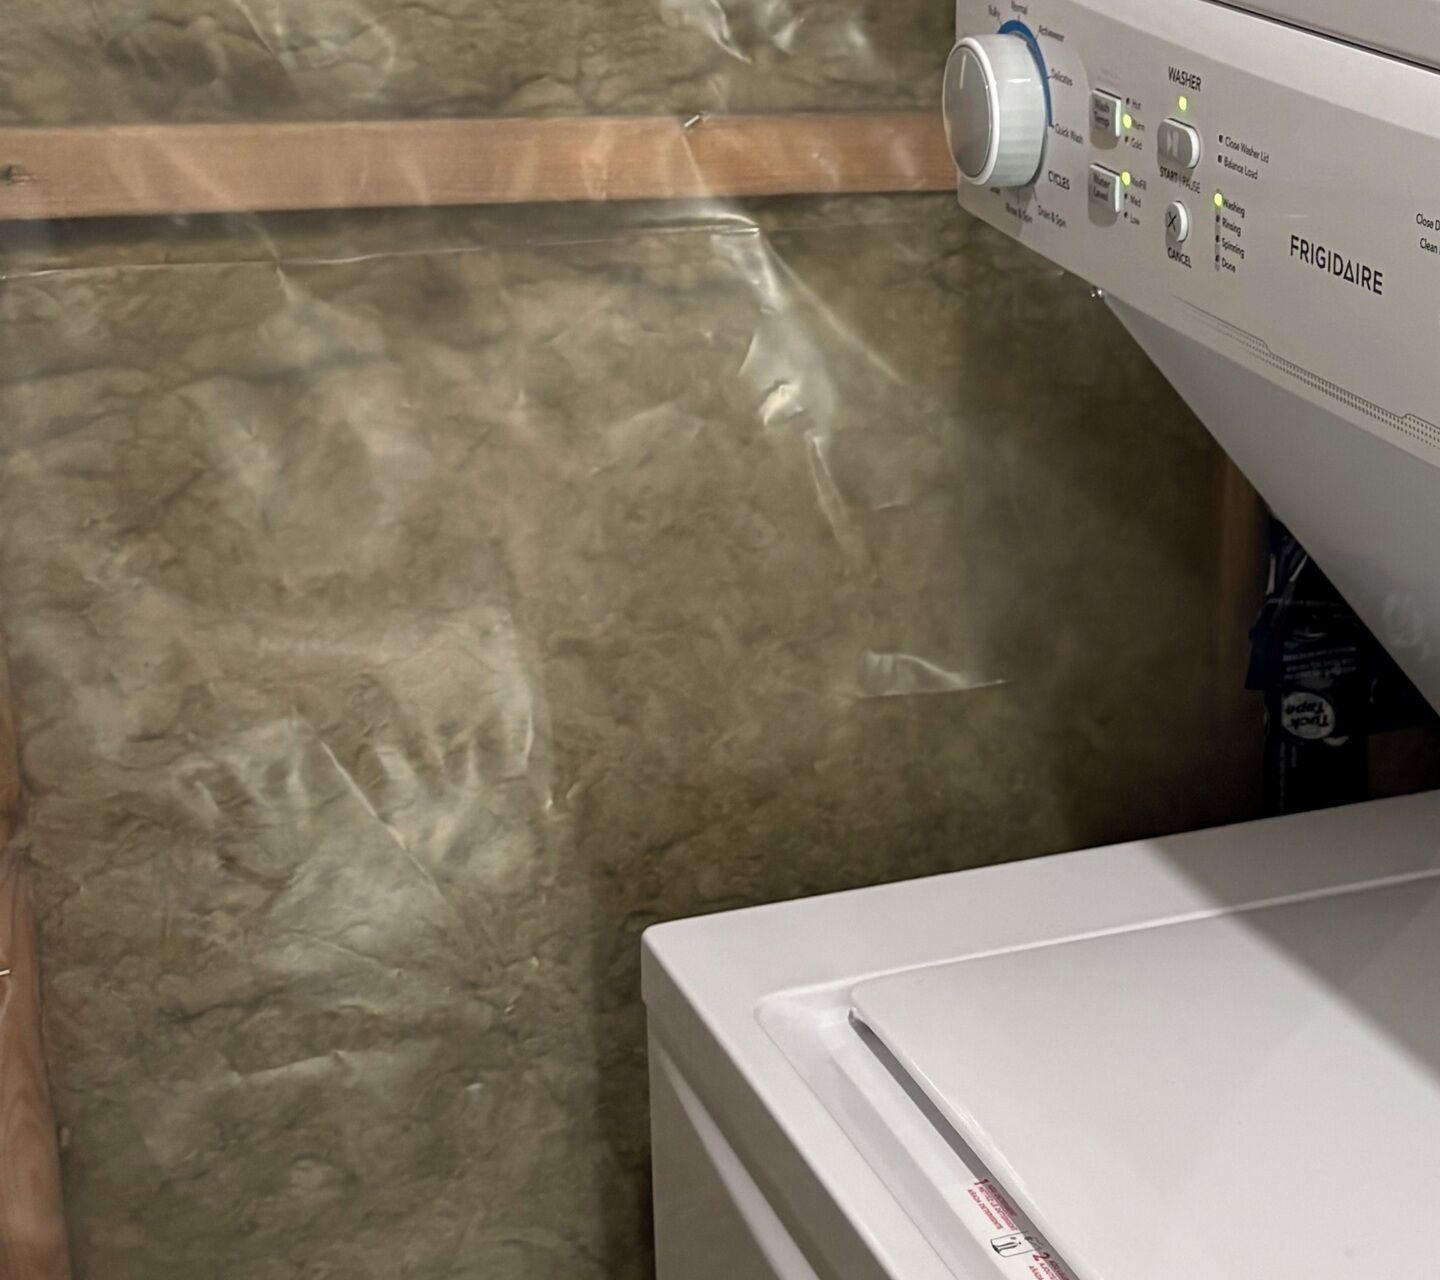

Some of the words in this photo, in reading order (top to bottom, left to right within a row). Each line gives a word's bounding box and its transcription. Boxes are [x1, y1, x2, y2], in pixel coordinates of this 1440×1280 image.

[1167, 66, 1202, 92] WASHER
[1225, 136, 1240, 151] Close
[1240, 142, 1260, 159] Washer
[1260, 151, 1269, 163] Lid
[1224, 155, 1243, 174] Balance
[1244, 165, 1258, 180] Load
[1048, 170, 1070, 190] CYCLES
[1160, 166, 1178, 184] START
[1182, 174, 1201, 194] PAUSE
[1222, 217, 1241, 237] Rinsing
[1415, 213, 1434, 230] Close
[1222, 237, 1245, 260] Spinning
[1419, 237, 1438, 254] Clean
[1167, 247, 1192, 269] CANCEL
[1221, 257, 1236, 272] Done
[1290, 234, 1384, 296] FRIGIDAIRE
[1285, 700, 1324, 715] Tape
[1291, 714, 1329, 730] Tuck
[1032, 1252, 1050, 1262] 2
